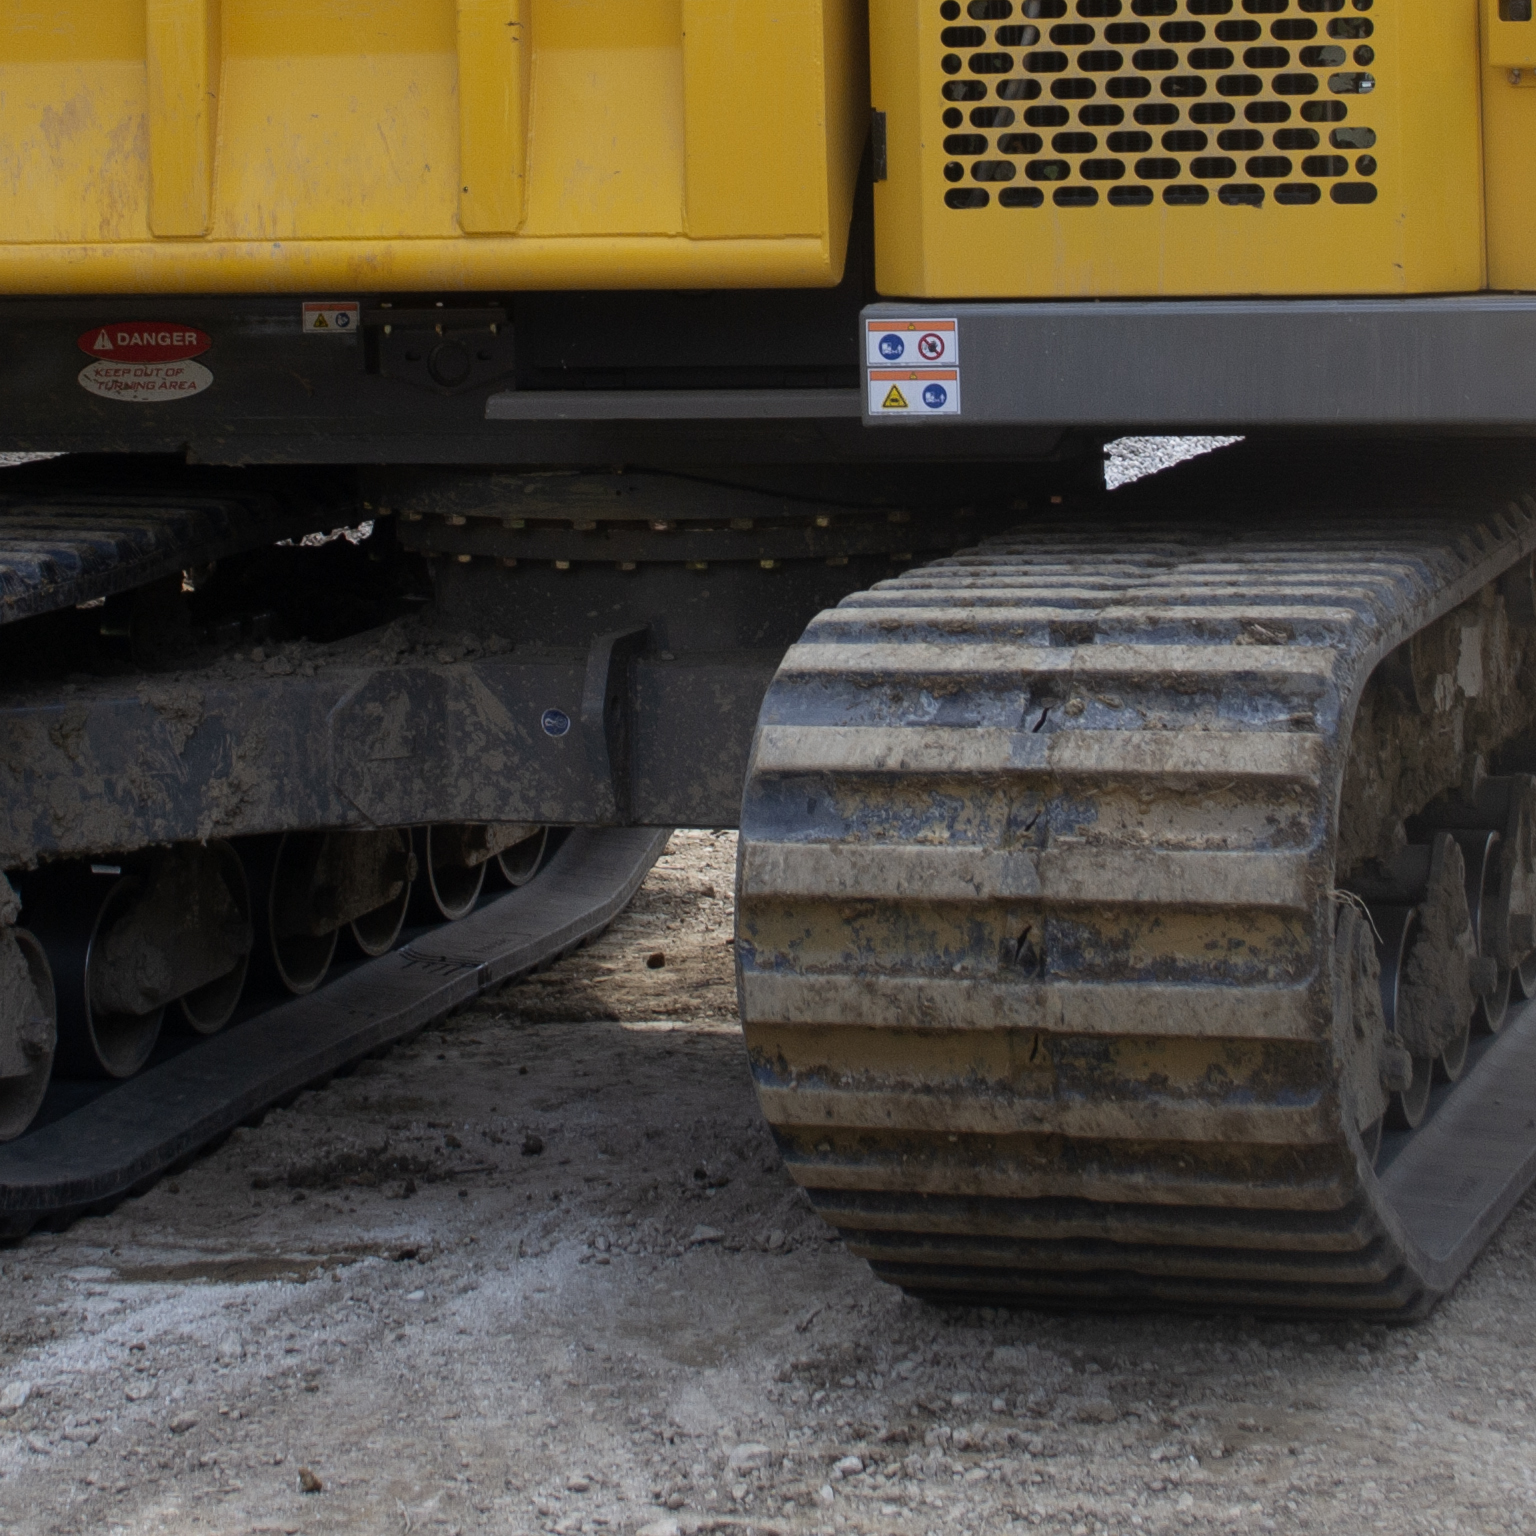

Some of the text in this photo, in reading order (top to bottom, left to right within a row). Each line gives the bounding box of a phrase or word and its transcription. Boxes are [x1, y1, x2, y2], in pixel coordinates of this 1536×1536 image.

[116, 331, 198, 346] DANGER
[93, 367, 131, 378] KEEP
[133, 367, 163, 378] OUT
[96, 380, 197, 391] TURNING AREA
